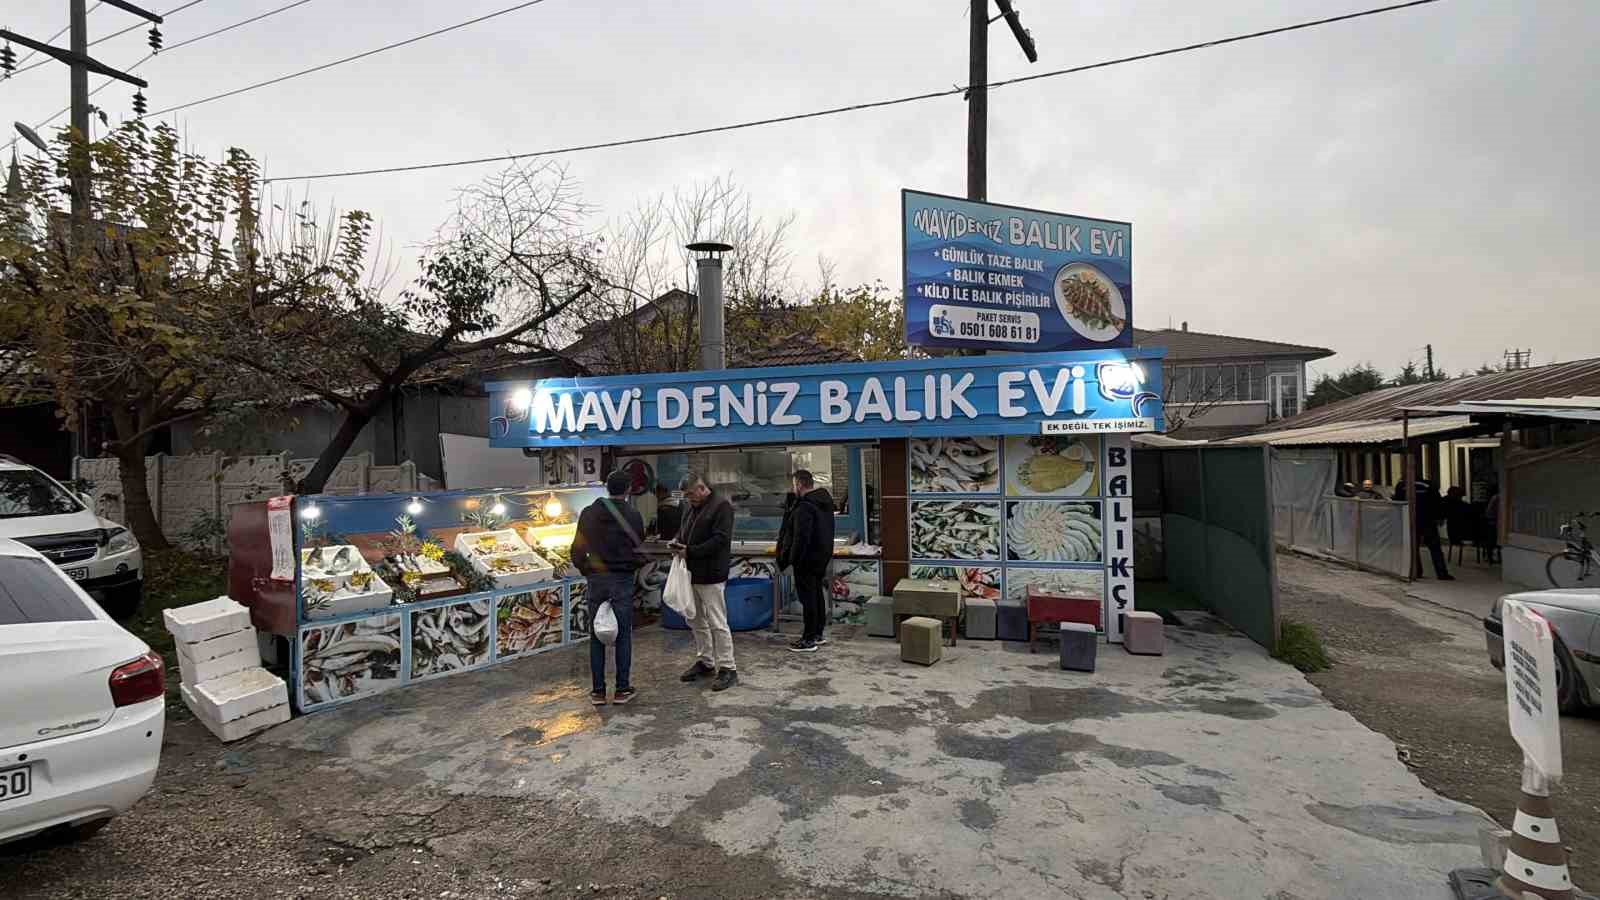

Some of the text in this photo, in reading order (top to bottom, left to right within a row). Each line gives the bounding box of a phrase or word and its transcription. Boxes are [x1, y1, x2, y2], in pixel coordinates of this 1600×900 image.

[1009, 217, 1081, 252] BALIK
[942, 247, 1044, 272] GÜNLÜK TAZE BALIK
[954, 269, 1024, 288] BALIK EKMEK
[924, 282, 1051, 308] KİLO İLE BALIK PİŞİRİLİR
[977, 312, 1022, 324] PAKET SERVİS
[960, 321, 1037, 340] 0501 608 61 81
[820, 371, 978, 424] BALIK
[1047, 423, 1060, 431] EK
[1062, 421, 1090, 431] DEĞİL
[1092, 422, 1111, 430] TEK
